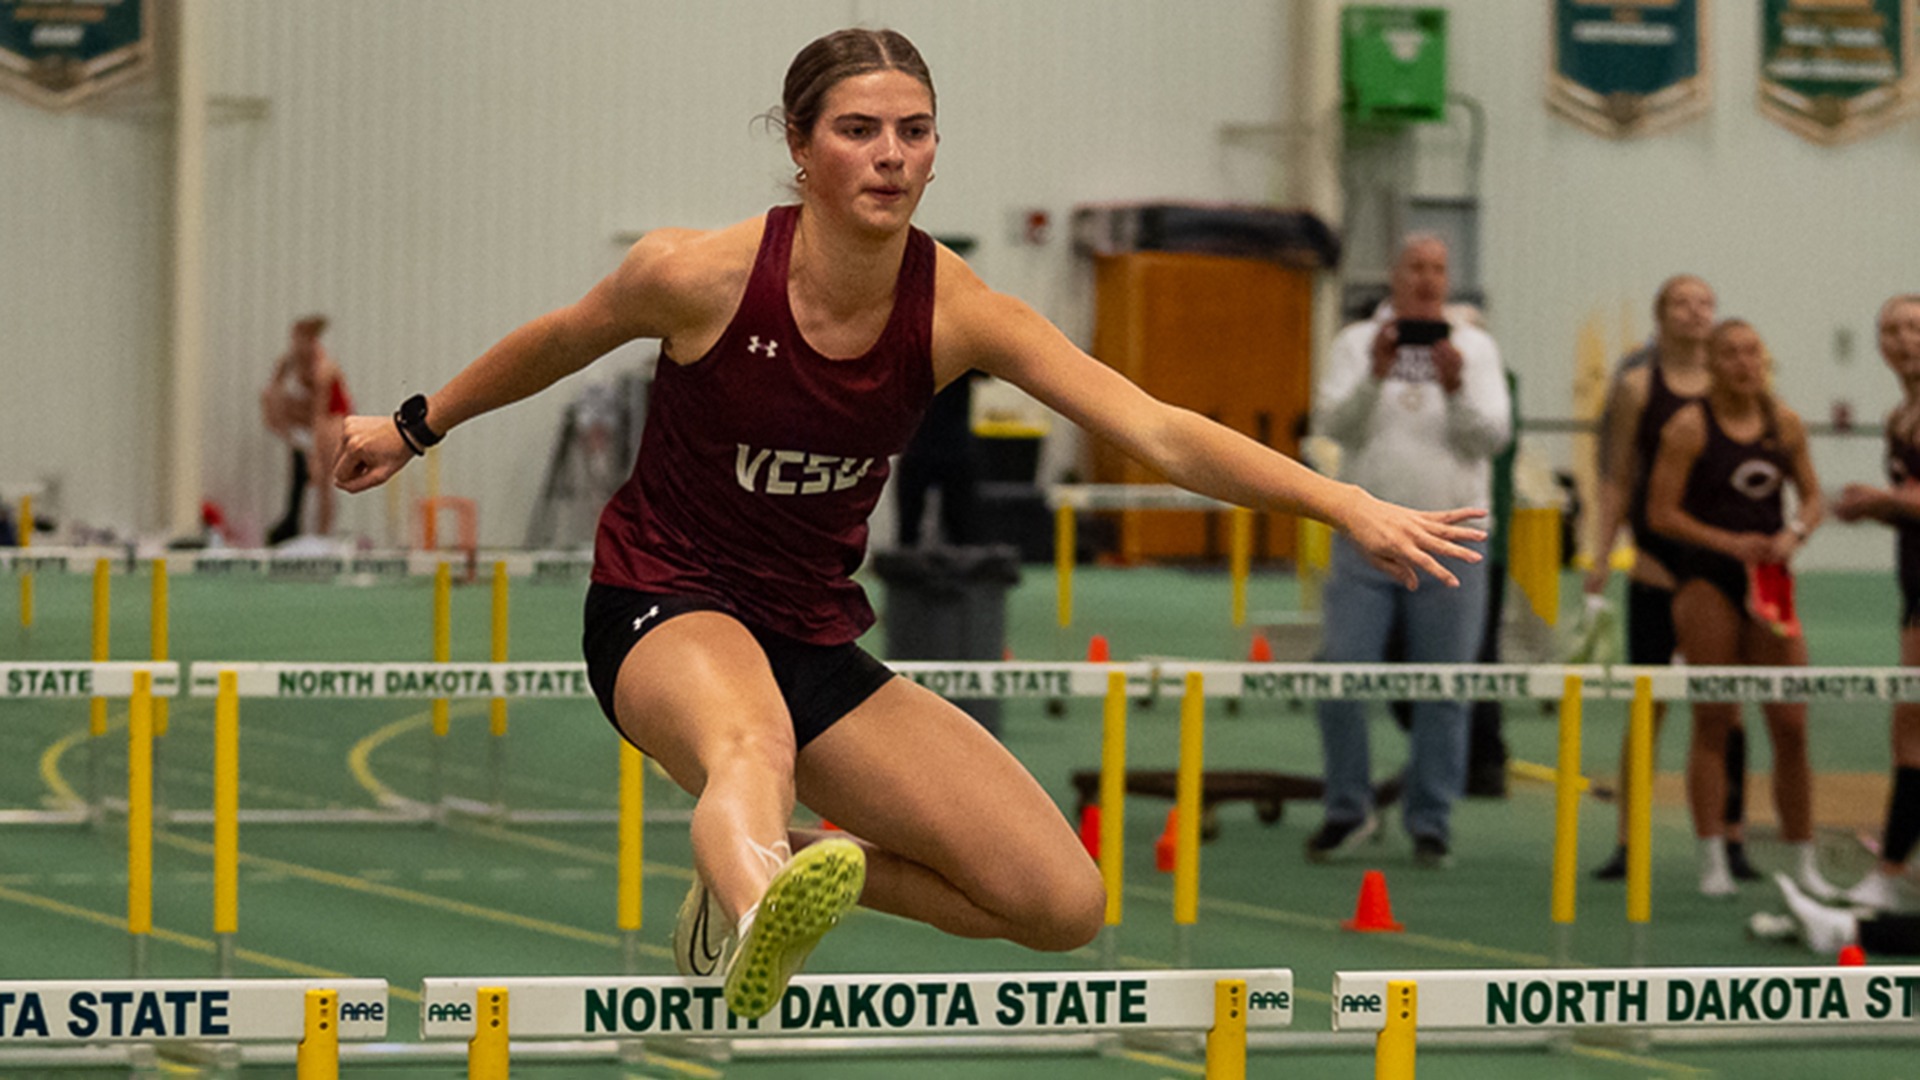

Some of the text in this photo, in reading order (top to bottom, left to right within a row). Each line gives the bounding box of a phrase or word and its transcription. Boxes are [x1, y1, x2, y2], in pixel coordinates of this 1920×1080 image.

[735, 443, 874, 495] VCSU
[7, 669, 94, 693] STATE
[278, 670, 587, 693] NORTH DAKOTA STATE
[902, 670, 1073, 696] KOTA STATE
[1241, 672, 1529, 696] NORTH DAKOTA STATE
[67, 990, 230, 1037] STATE
[780, 983, 979, 1029] DAKOTA
[995, 980, 1147, 1026] STATE
[1486, 980, 1648, 1024] NORTH
[1667, 977, 1850, 1021] DAKOTA
